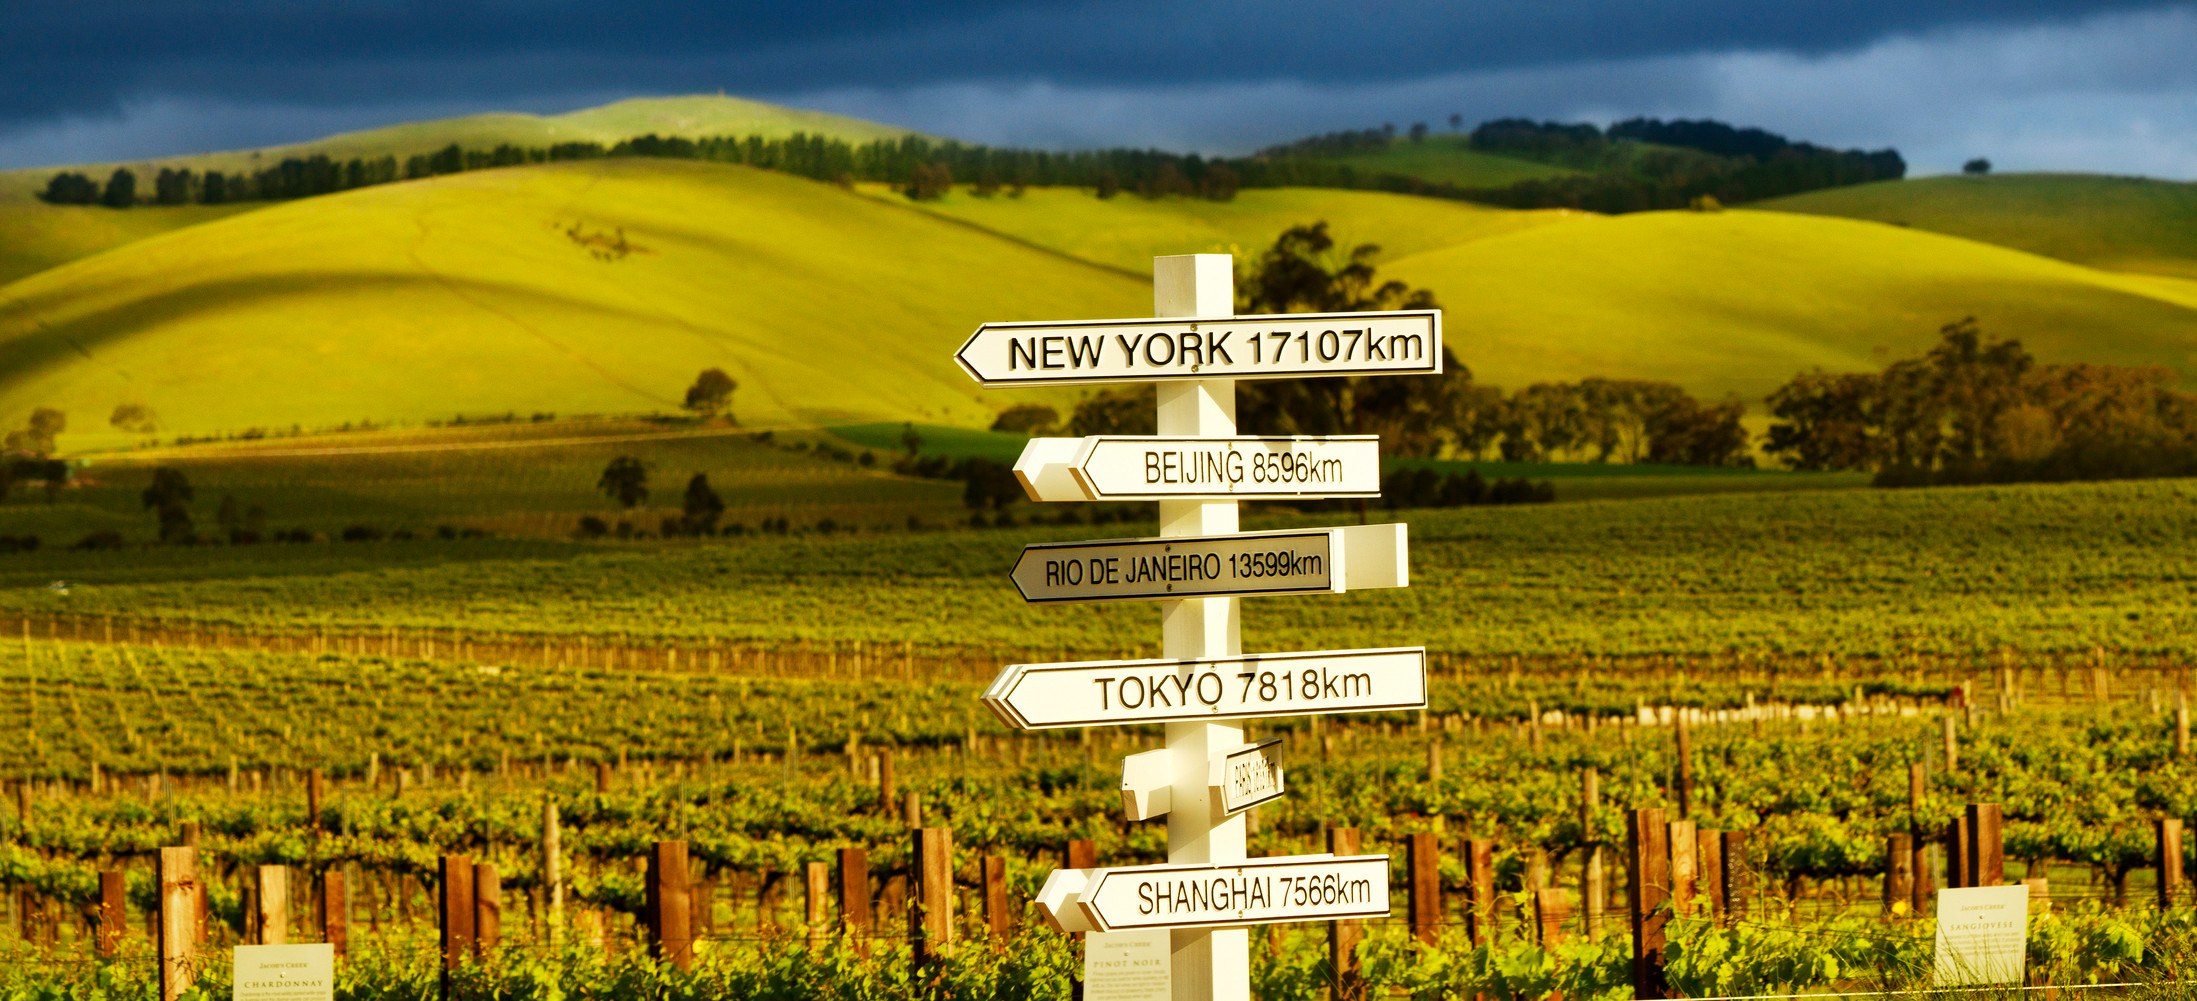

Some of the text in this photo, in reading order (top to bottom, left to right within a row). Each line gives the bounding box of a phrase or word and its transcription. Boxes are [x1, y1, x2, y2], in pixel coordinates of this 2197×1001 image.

[1010, 326, 1423, 370] NEW YORK 17107km
[1145, 450, 1343, 485] BEIJING 8596km
[1046, 548, 1322, 587] RIO DE JANEIRO 13599km
[1094, 666, 1371, 711] TOKYO 7818km
[1137, 873, 1371, 916] SHANGHAI 7566km
[1951, 921, 2012, 930] SANGIOVESE
[1093, 960, 1128, 968] PINOT
[244, 980, 323, 988] CHARDONNAY
